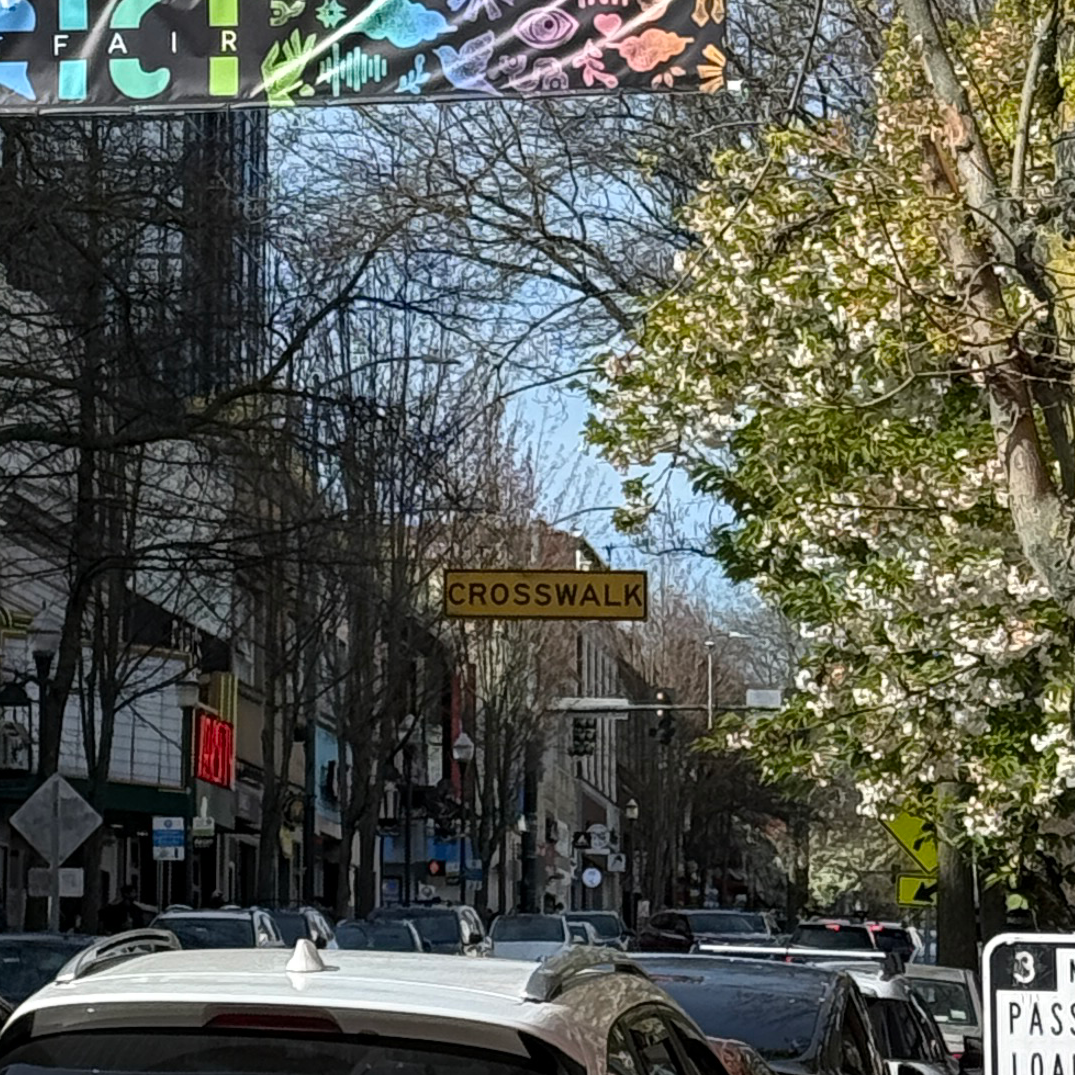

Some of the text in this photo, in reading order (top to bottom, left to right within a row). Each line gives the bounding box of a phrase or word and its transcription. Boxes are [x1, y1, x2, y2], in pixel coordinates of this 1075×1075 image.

[53, 31, 237, 56] FAIR
[448, 582, 643, 607] CROSSWALK
[1013, 950, 1036, 984] 3
[1012, 1052, 1075, 1075] LOA
